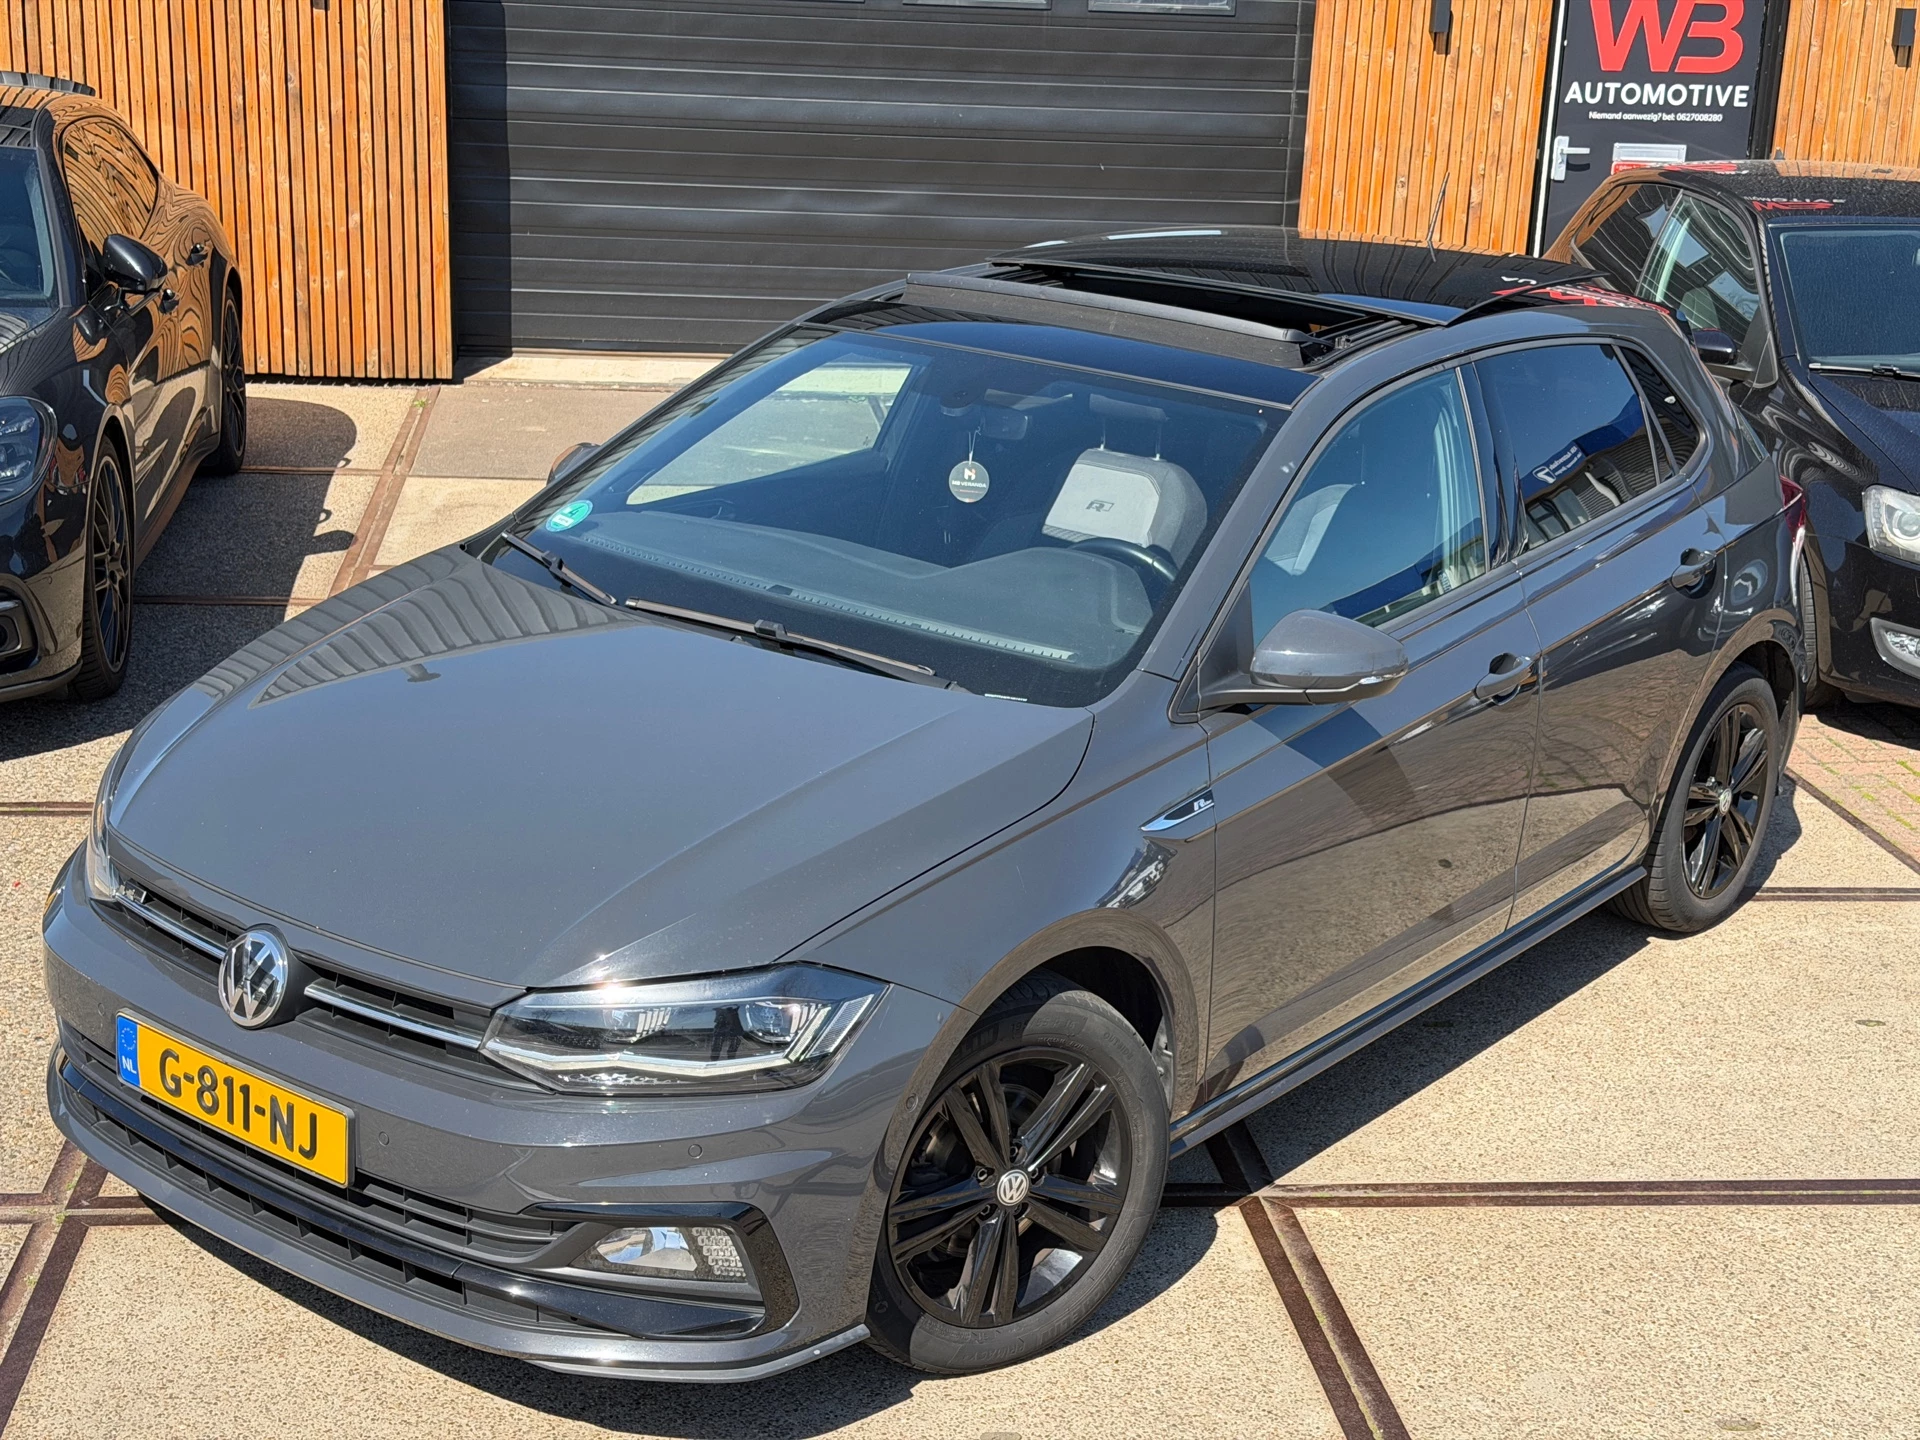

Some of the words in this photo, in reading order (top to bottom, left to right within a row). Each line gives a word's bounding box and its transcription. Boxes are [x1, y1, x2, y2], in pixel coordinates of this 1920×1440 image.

[1590, 0, 1745, 74] WB
[1564, 81, 1750, 108] AUTOMOTIVE
[1588, 111, 1622, 120] Niemand
[1622, 112, 1662, 123] aanwezig?
[121, 1054, 138, 1075] NL
[159, 1048, 318, 1161] G-811-NJ
[998, 1170, 1028, 1205] VW
